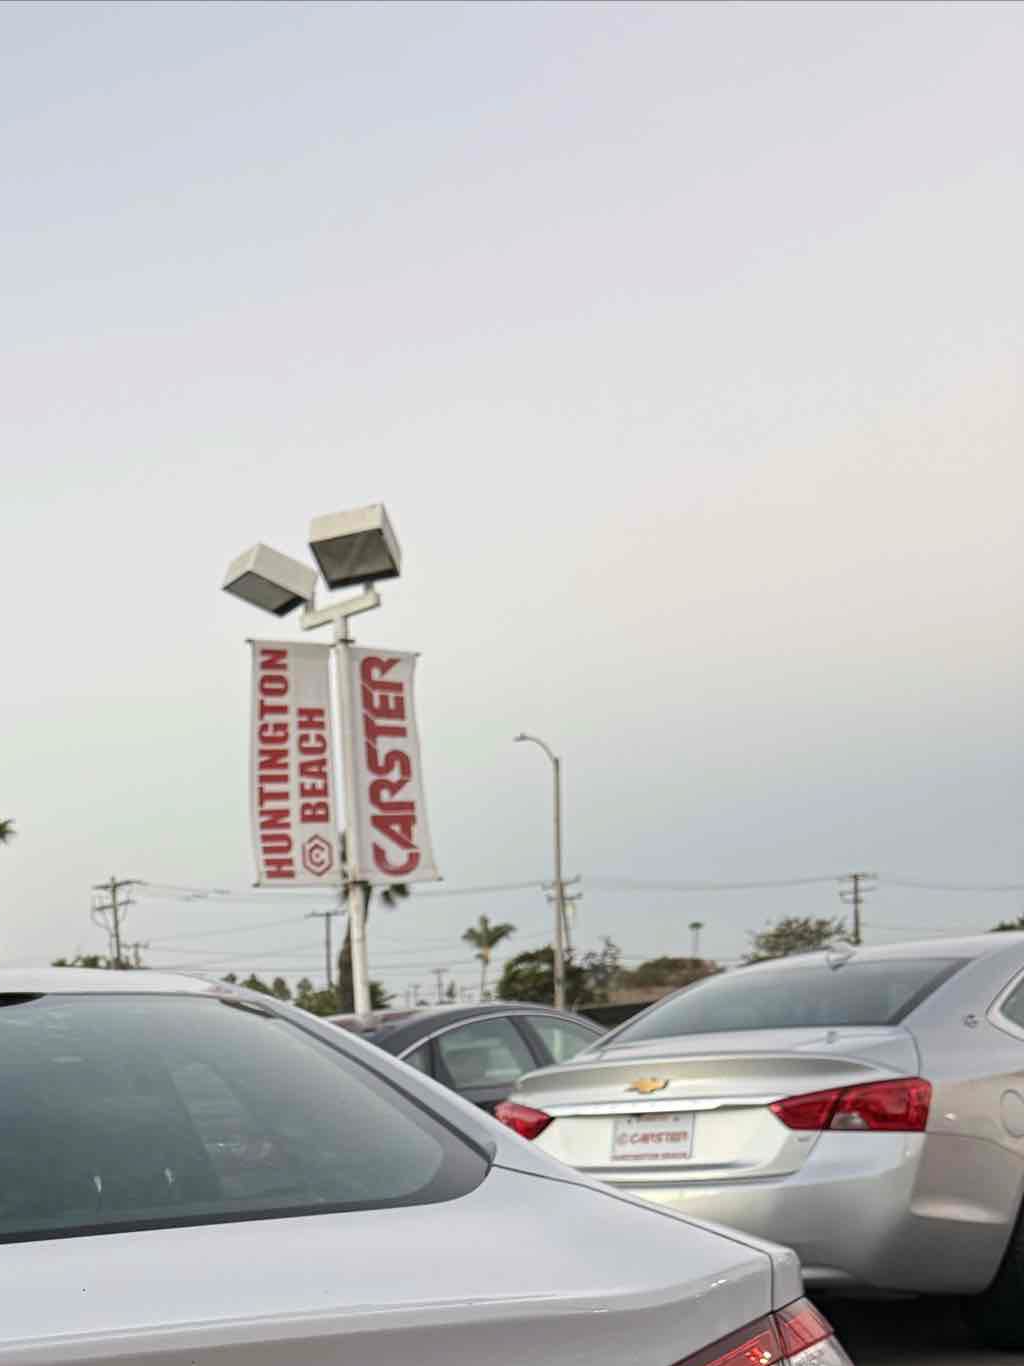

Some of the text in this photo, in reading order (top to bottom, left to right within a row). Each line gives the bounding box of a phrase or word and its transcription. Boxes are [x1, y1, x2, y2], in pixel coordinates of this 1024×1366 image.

[258, 649, 295, 879] HUNTINGTON
[297, 707, 329, 824] BEACH
[360, 655, 420, 876] CARSTER
